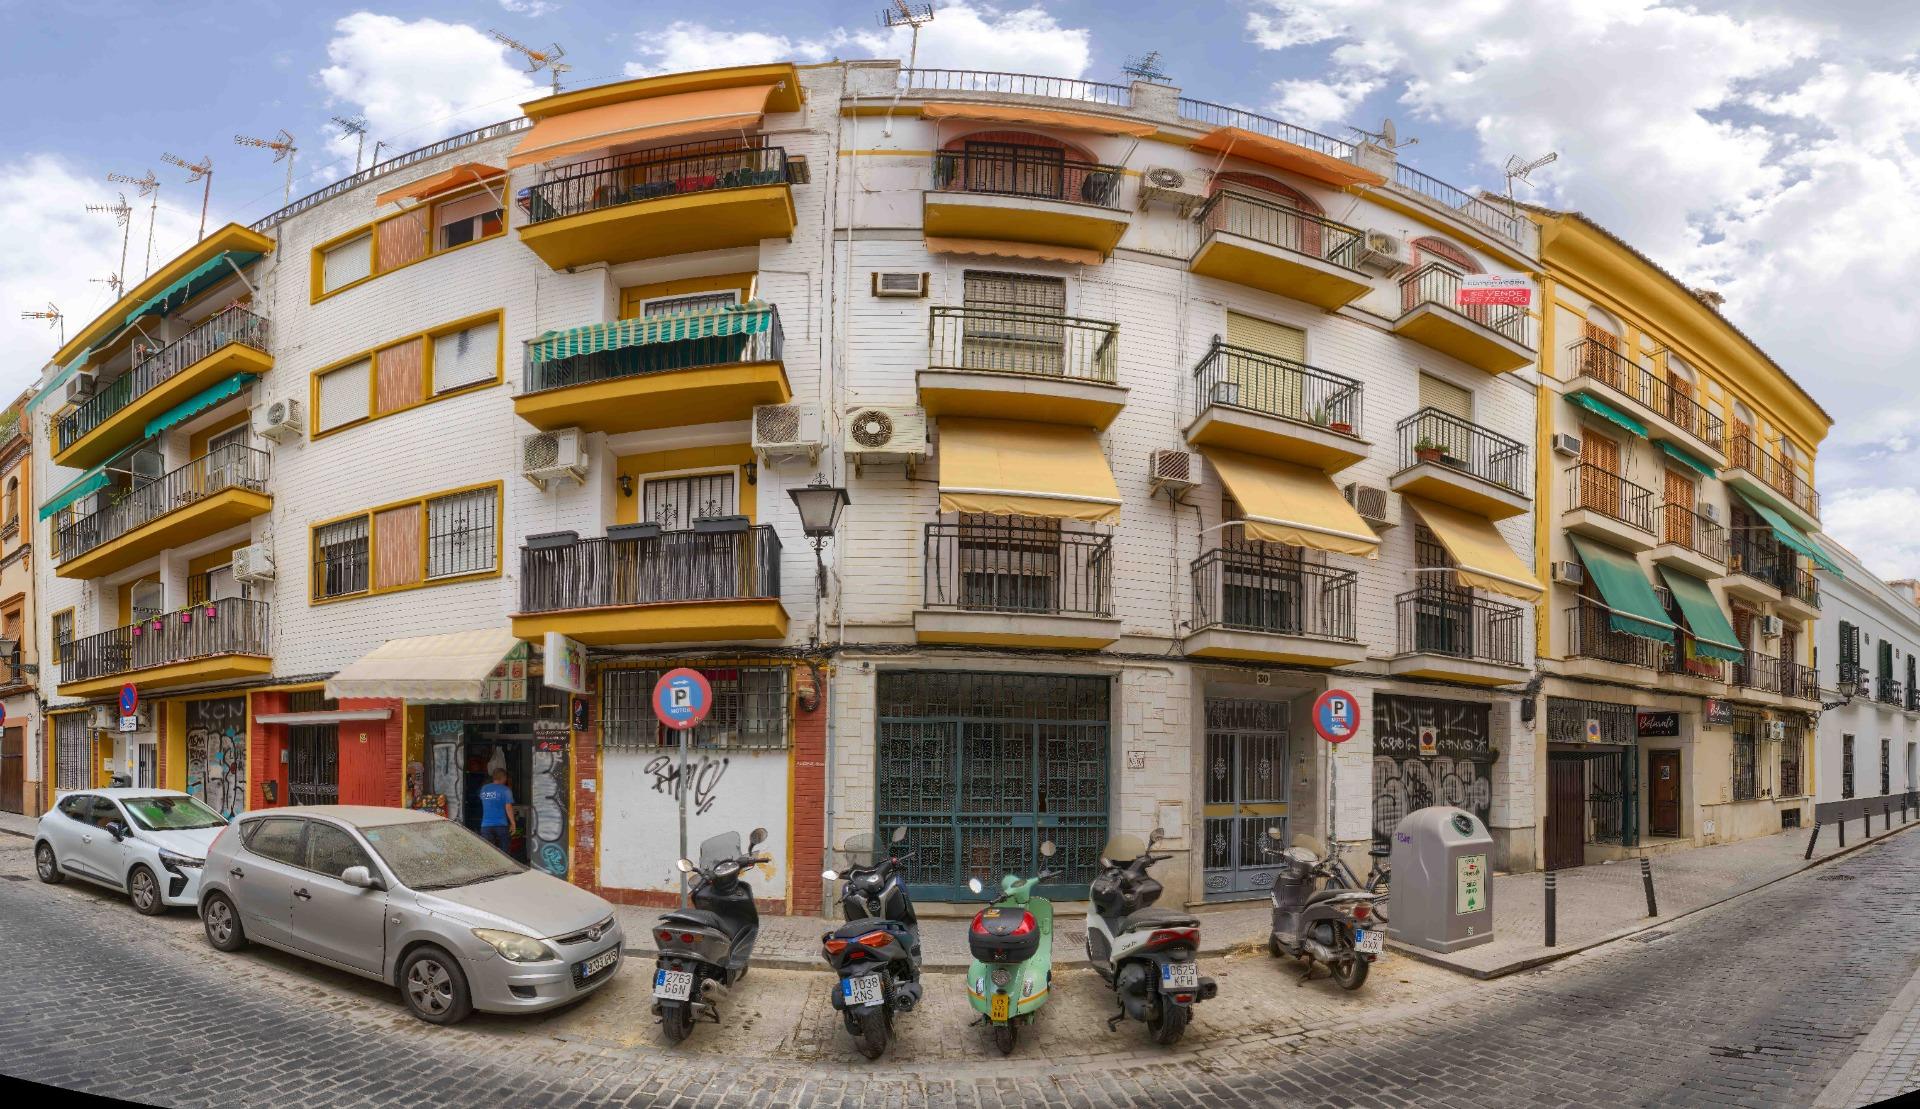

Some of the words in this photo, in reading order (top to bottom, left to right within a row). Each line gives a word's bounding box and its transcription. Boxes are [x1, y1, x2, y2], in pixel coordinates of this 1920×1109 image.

[1257, 674, 1269, 684] 30
[674, 689, 687, 706] P
[1334, 700, 1345, 715] P
[666, 972, 691, 985] 2763
[853, 977, 879, 991] 1038
[853, 989, 874, 1003] KNS
